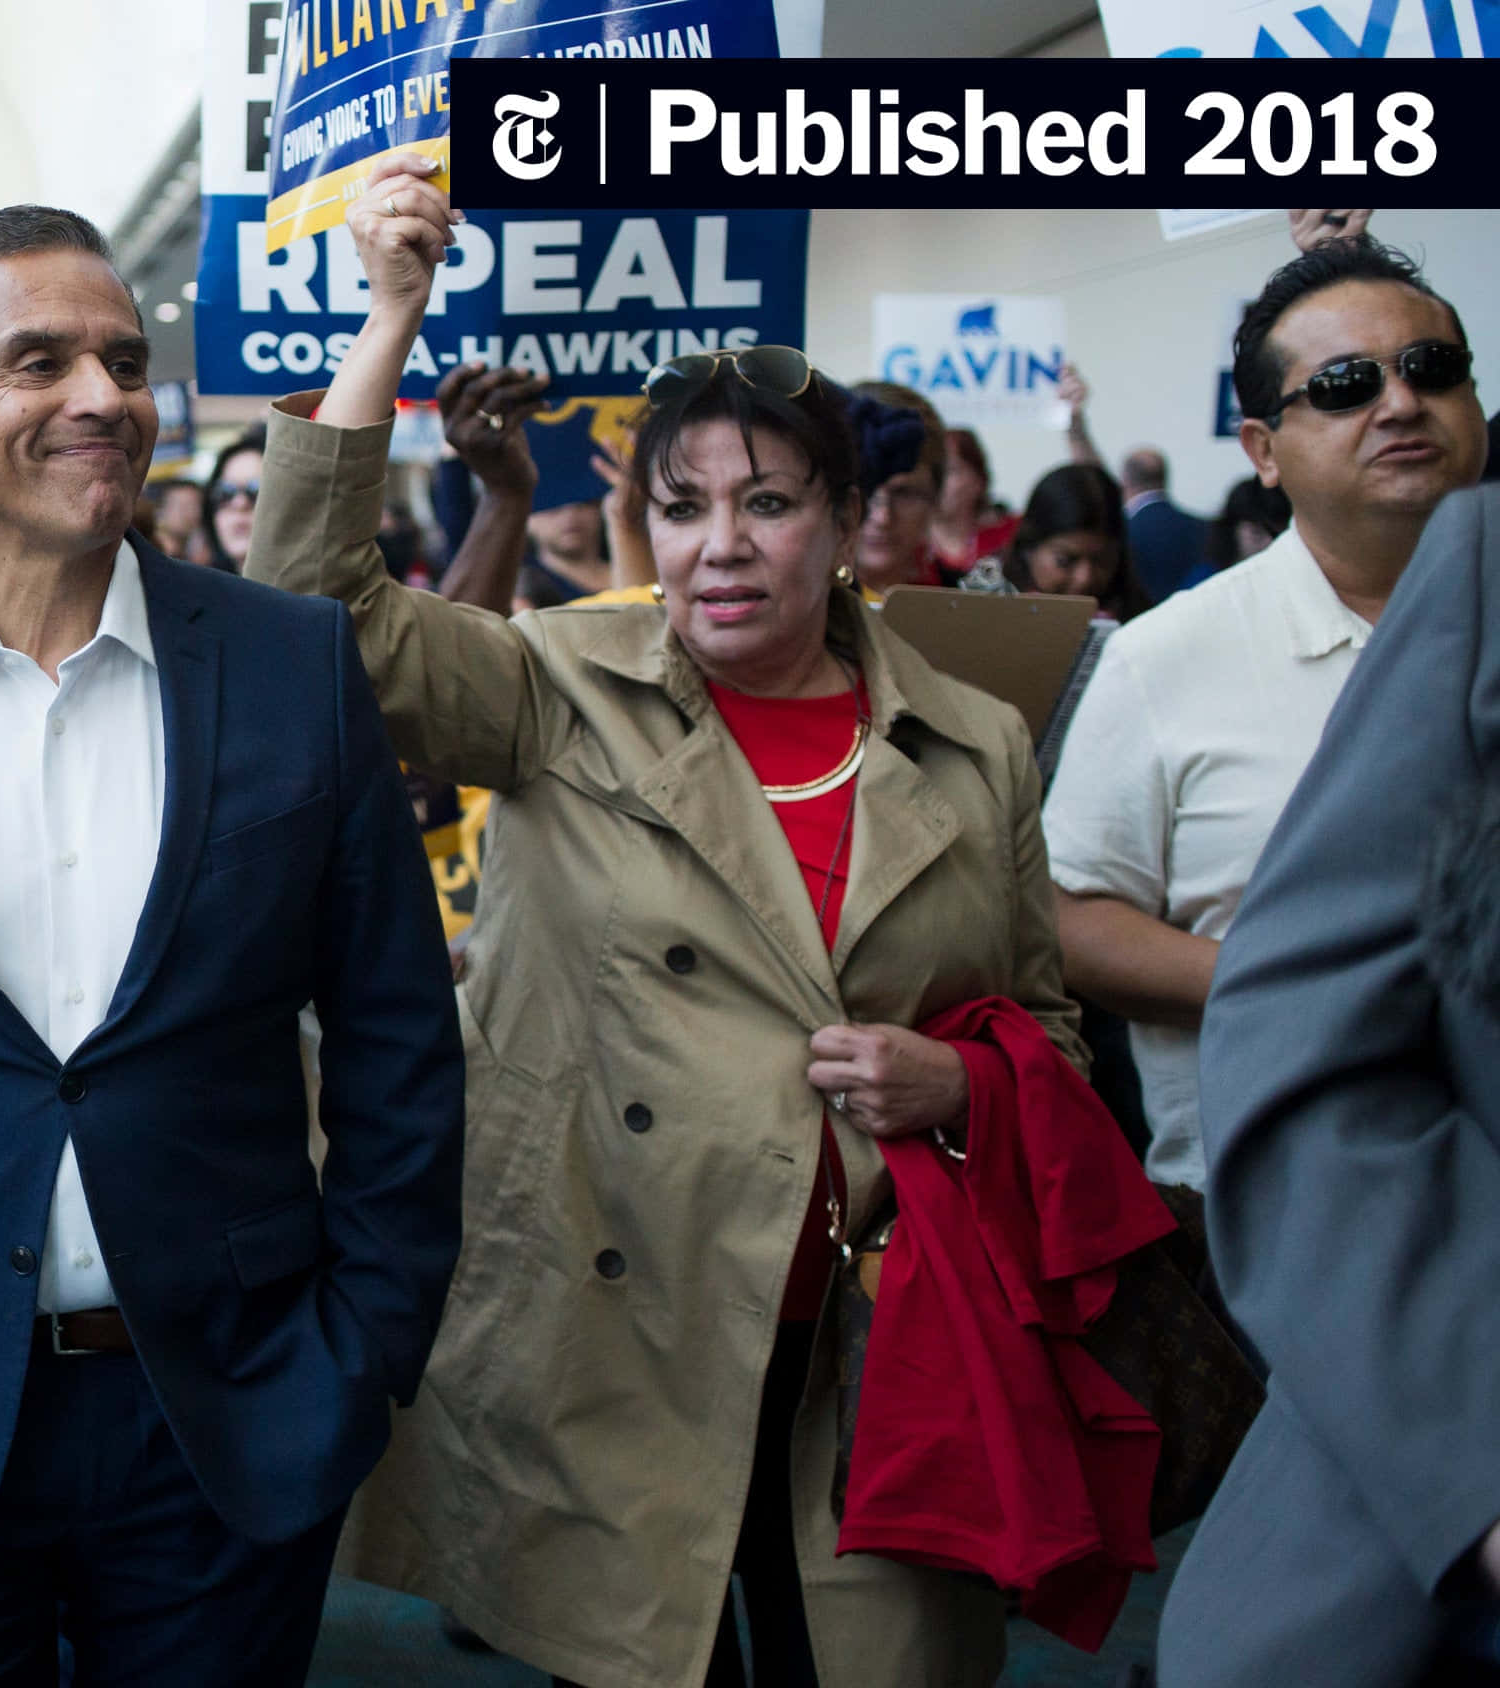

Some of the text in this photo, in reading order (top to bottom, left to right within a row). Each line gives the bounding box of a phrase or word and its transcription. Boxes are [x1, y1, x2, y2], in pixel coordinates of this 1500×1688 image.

[282, 115, 324, 172] GIVING
[325, 94, 371, 148] VOICE
[372, 84, 396, 129] TO
[241, 326, 760, 378] COSA-HAWKINS
[883, 347, 1062, 390] GAVIN
